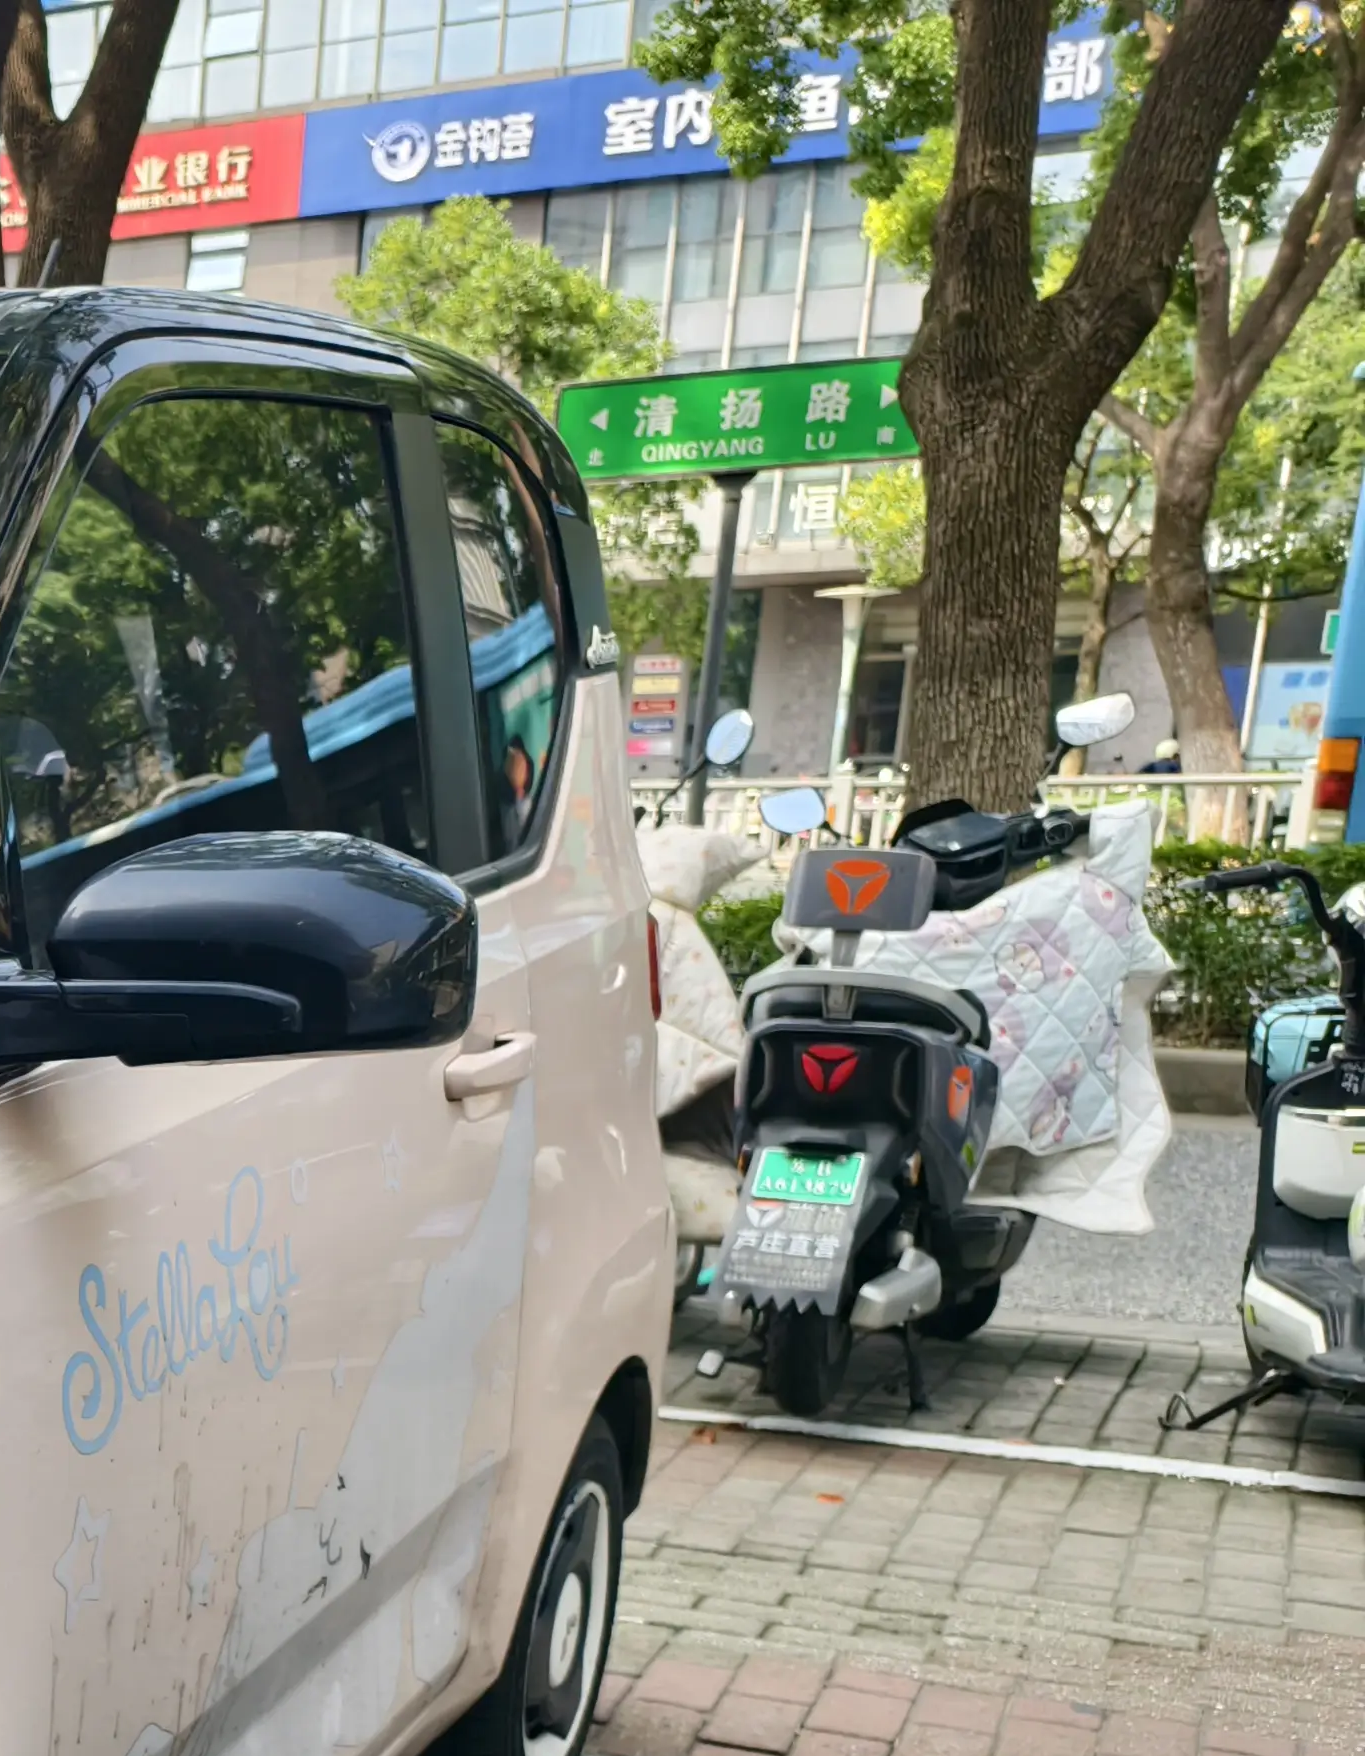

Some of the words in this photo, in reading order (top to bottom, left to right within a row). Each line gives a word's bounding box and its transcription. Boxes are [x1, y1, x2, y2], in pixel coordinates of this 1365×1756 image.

[125, 145, 253, 194] 业银行
[634, 380, 852, 438] 清扬路
[640, 436, 765, 464] QINGYANG
[804, 431, 837, 452] LU
